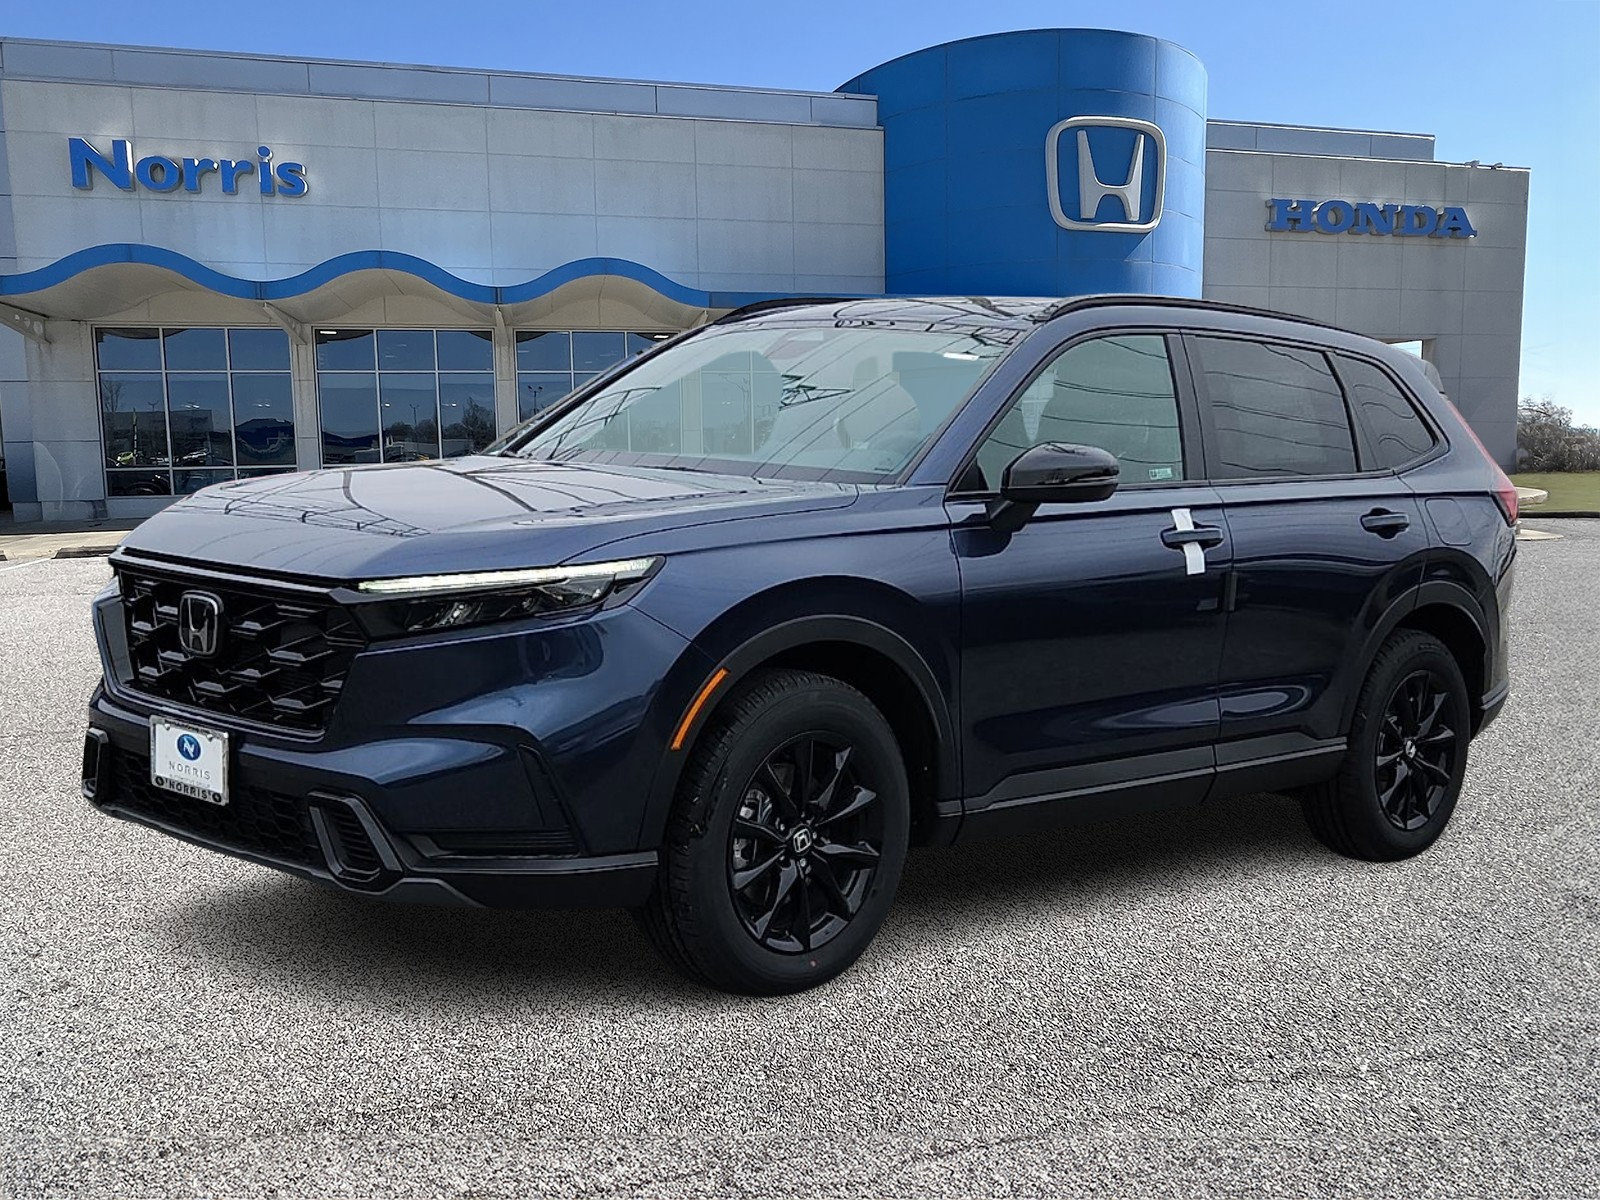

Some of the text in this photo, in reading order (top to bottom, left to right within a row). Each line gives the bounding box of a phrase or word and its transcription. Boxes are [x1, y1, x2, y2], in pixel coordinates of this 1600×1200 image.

[68, 137, 309, 197] Norris
[1265, 198, 1478, 239] HONDA
[169, 760, 211, 781] NORRIS
[169, 780, 208, 799] NORRIS
